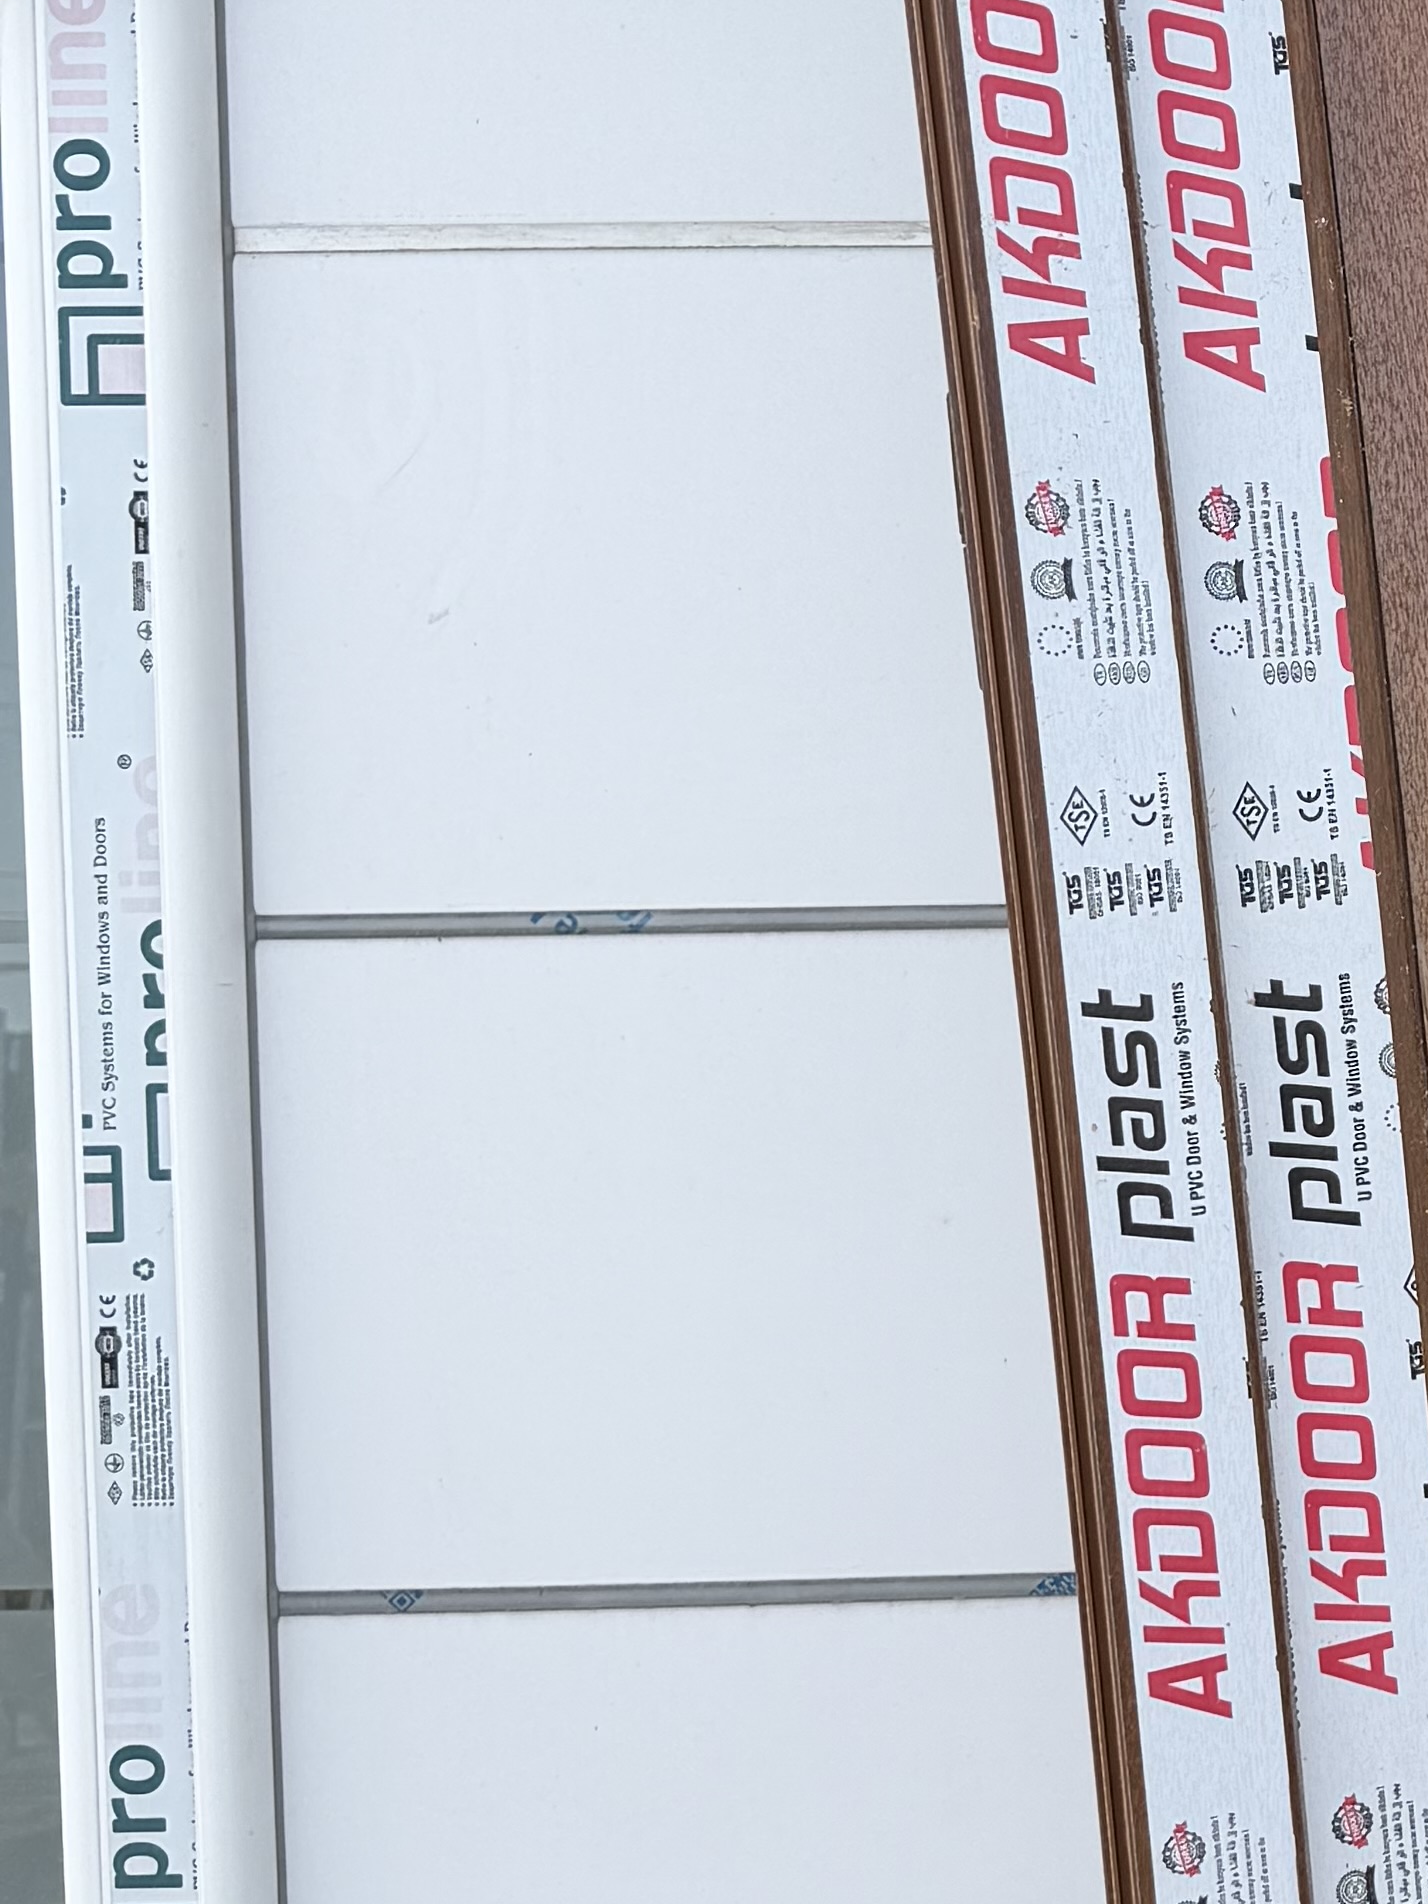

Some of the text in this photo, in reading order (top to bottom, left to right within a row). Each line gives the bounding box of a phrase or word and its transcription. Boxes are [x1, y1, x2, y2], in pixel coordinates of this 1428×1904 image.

[93, 817, 118, 1130] PVC Systems for Windows and Doors
[1296, 788, 1323, 822] CE
[1080, 988, 1232, 1719] AKDOOR plast
[1254, 979, 1397, 1695] AKDOOR plast
